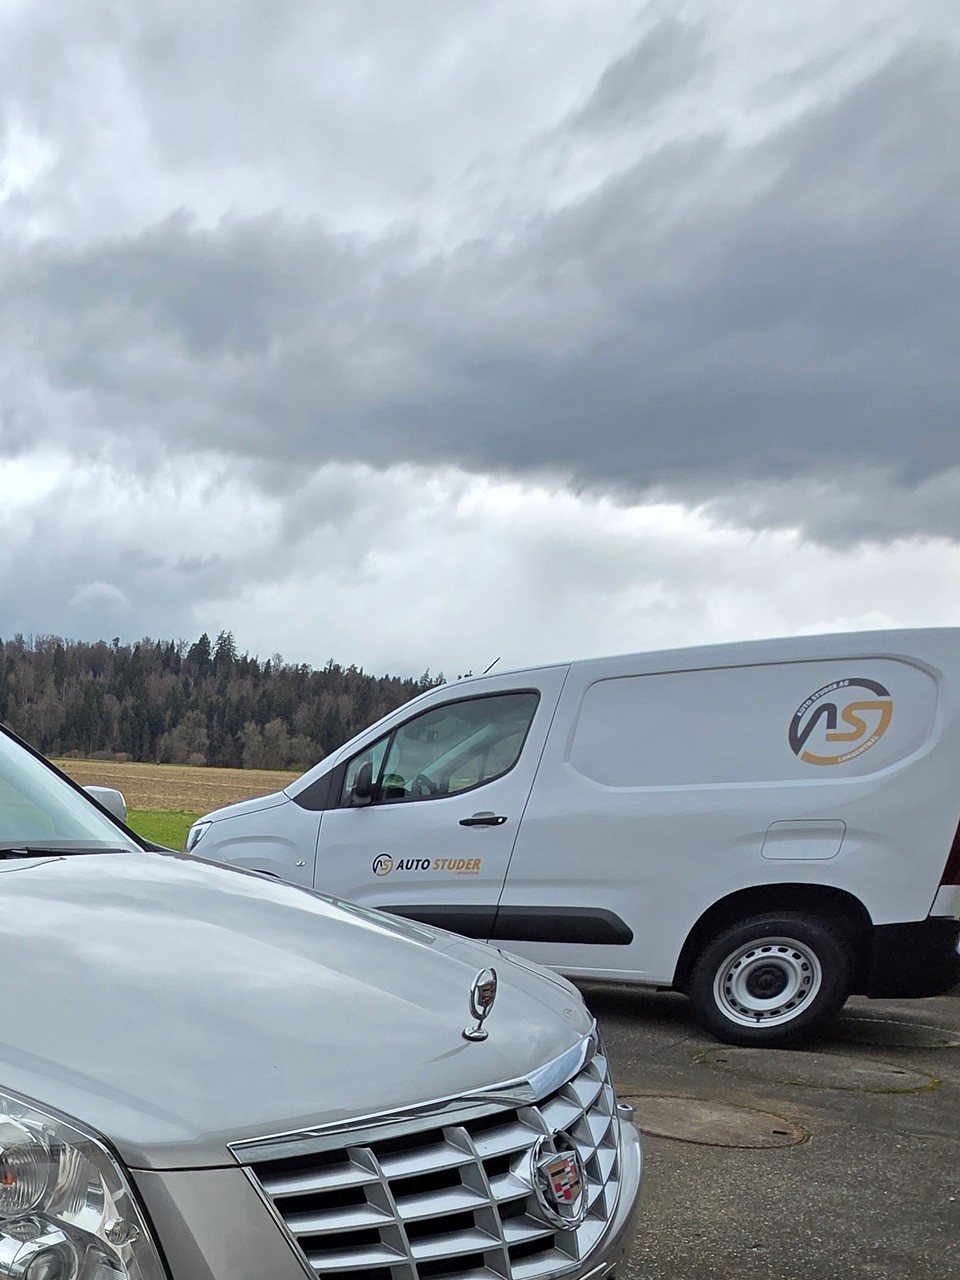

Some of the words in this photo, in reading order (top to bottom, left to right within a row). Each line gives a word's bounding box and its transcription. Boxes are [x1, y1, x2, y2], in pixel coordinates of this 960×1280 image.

[838, 680, 850, 688] AG
[396, 858, 431, 871] AUTO
[432, 858, 481, 871] STUDER
